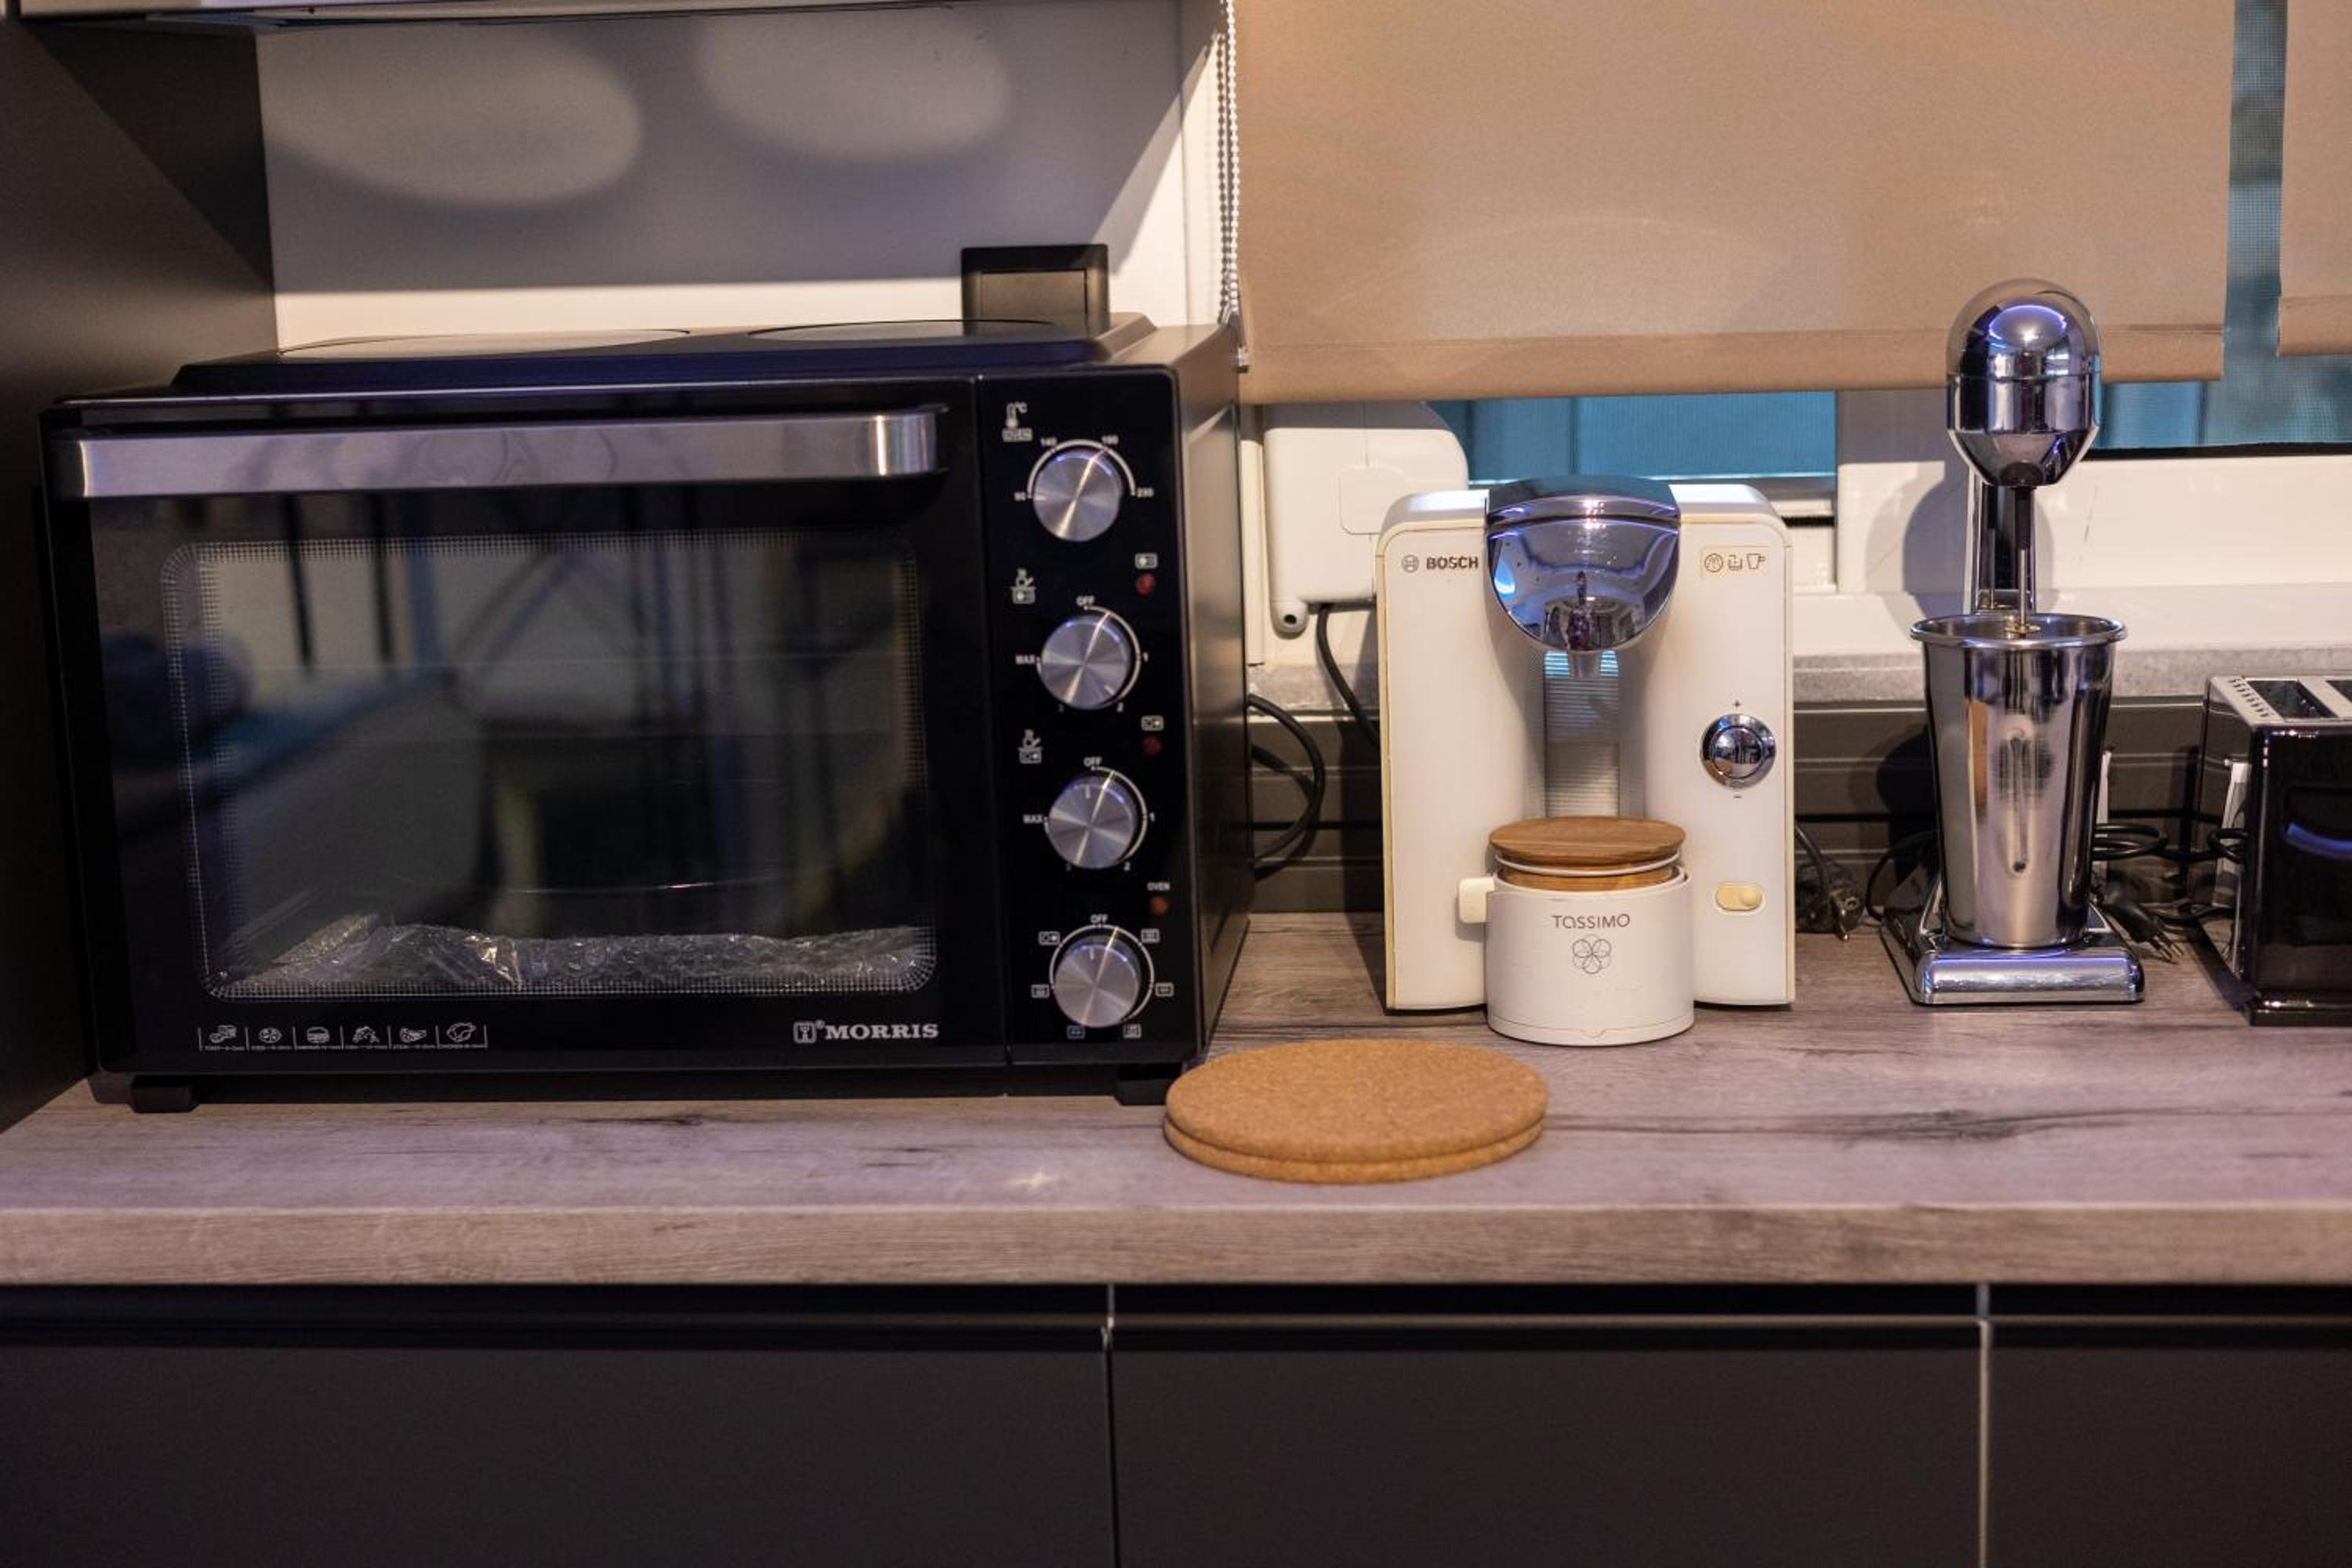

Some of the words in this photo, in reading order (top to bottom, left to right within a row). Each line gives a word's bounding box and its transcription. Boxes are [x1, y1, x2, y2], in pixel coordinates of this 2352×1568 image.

[1426, 556, 1479, 570] BOSCH
[1076, 596, 1095, 607] OFF
[1016, 655, 1036, 665] MAX
[1083, 757, 1103, 767] OFF
[1023, 815, 1043, 824] MAX
[1147, 882, 1171, 891] OVEN
[1091, 914, 1109, 924] OFF
[825, 1023, 939, 1040] MORRIS
